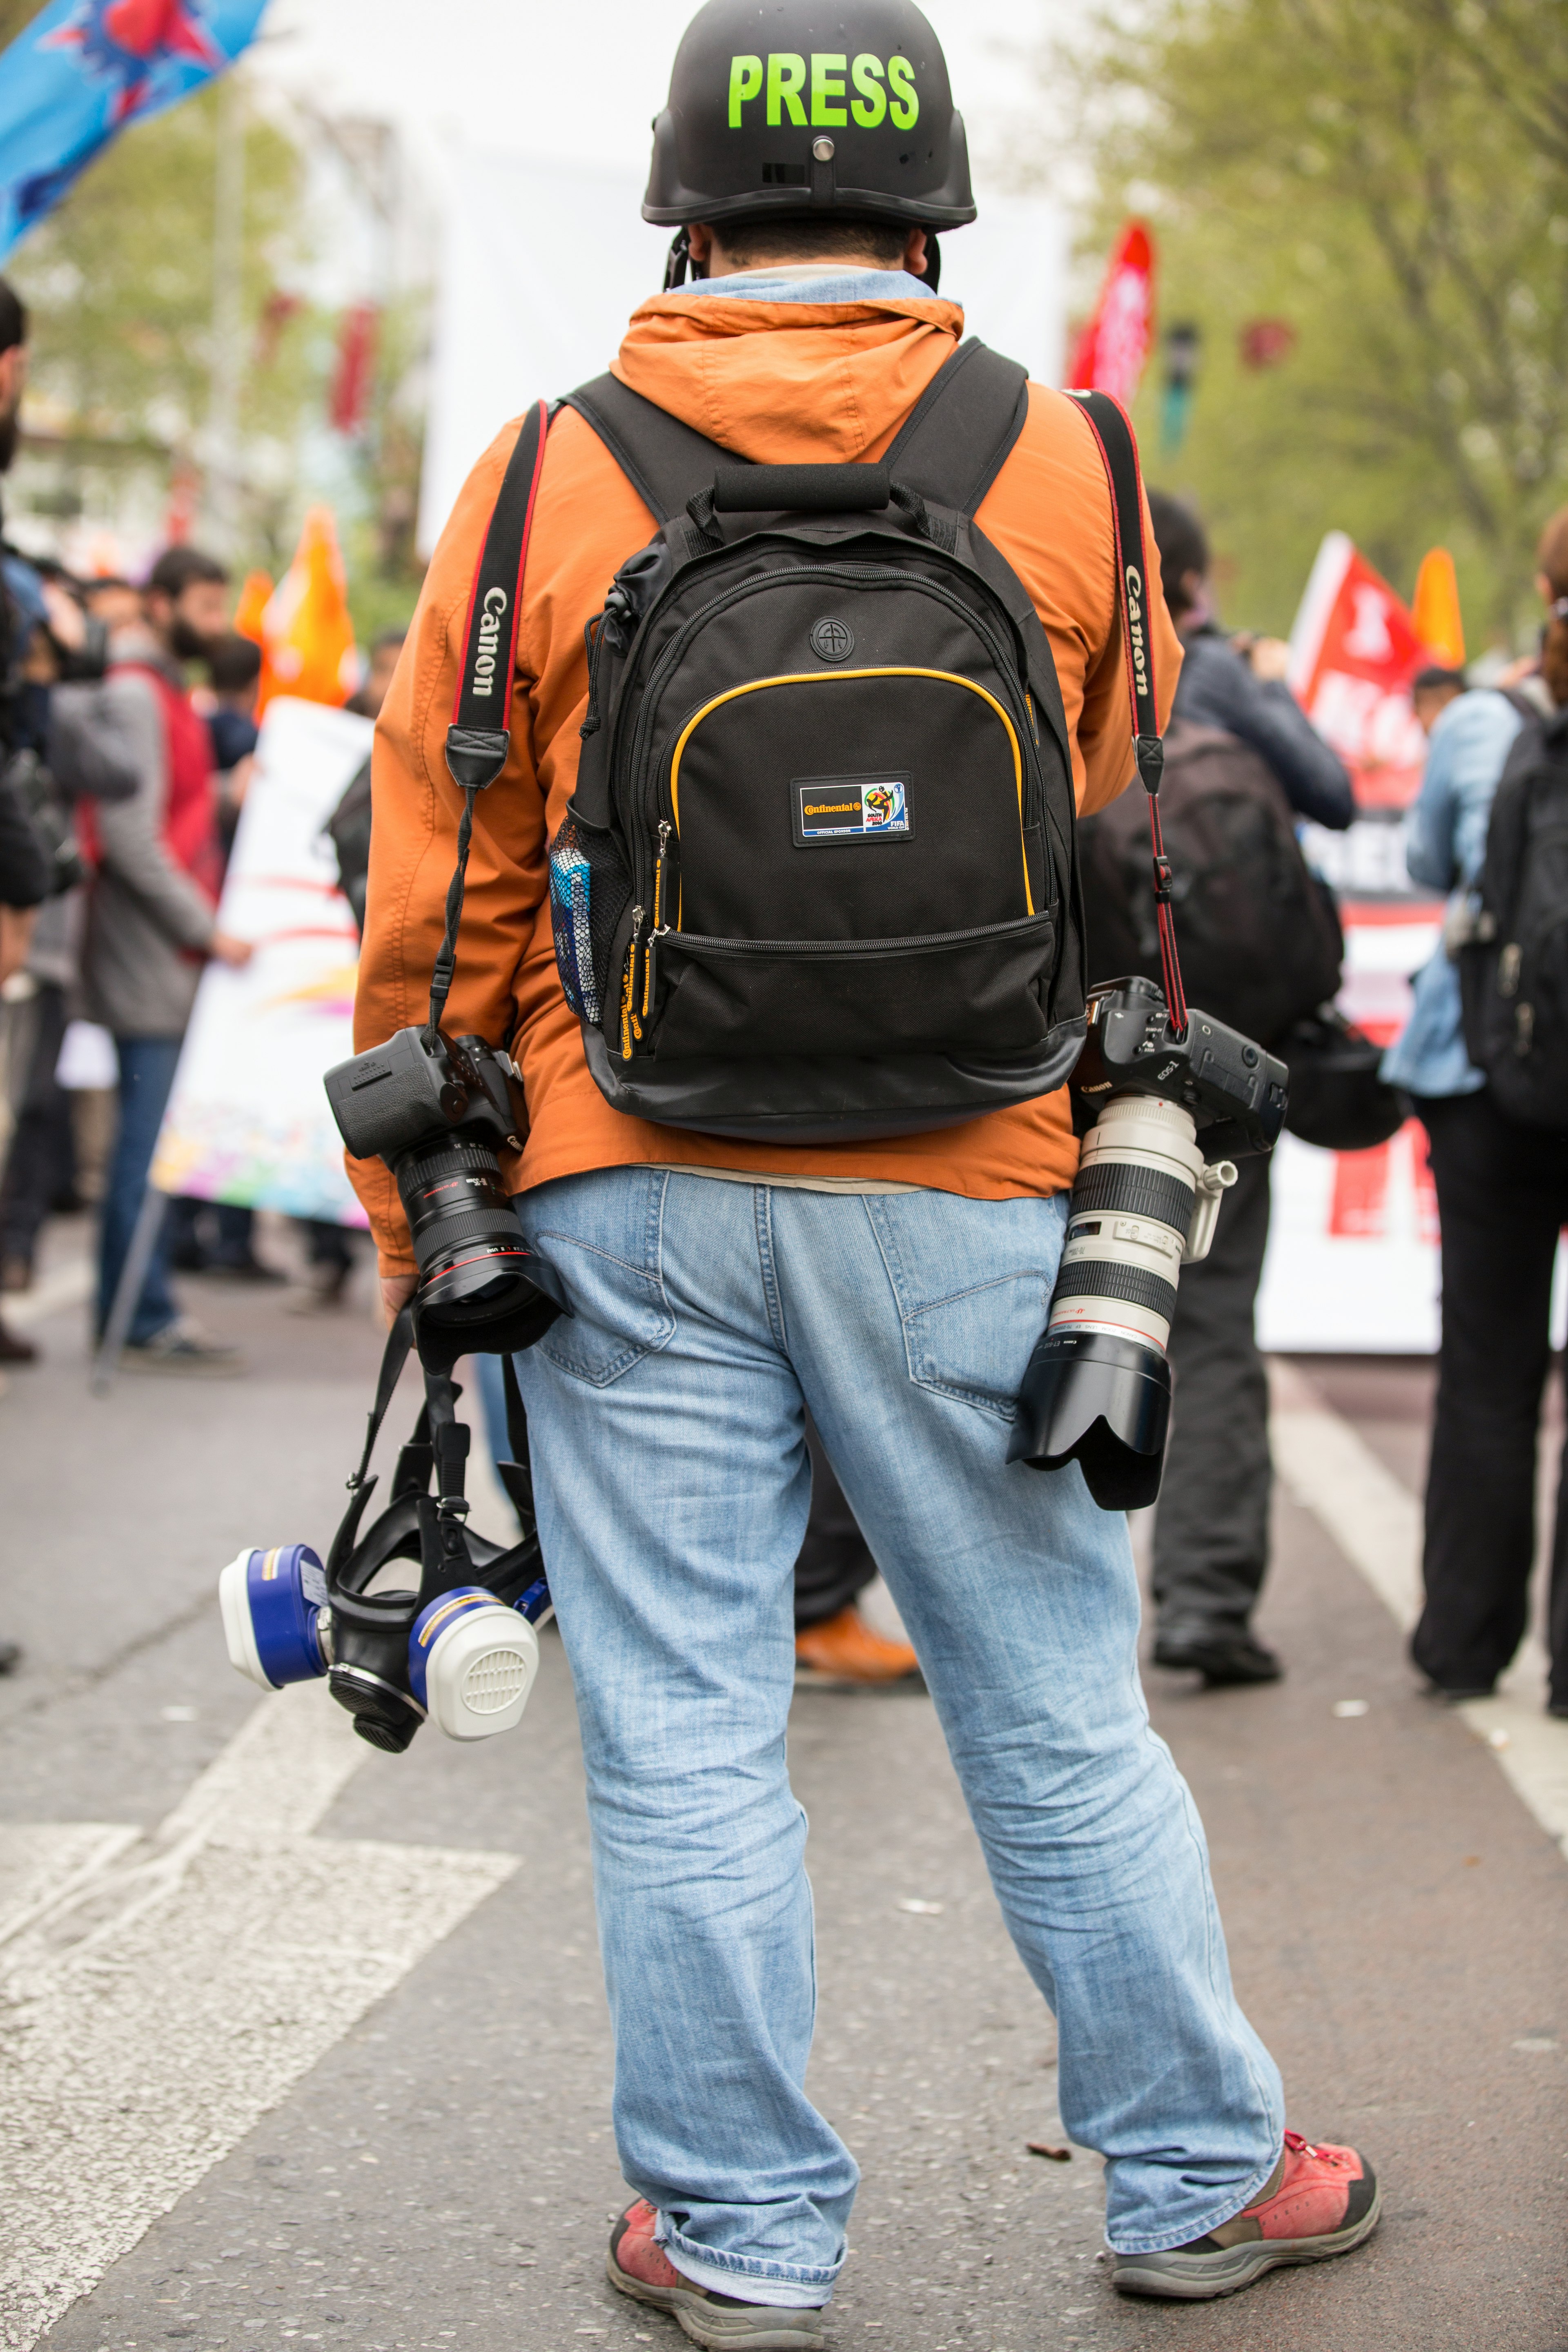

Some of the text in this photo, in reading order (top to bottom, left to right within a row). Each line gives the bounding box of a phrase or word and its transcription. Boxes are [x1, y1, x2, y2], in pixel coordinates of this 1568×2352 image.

[728, 53, 920, 130] PRESS
[472, 587, 507, 697] Canon
[1126, 565, 1148, 696] Canon
[804, 802, 853, 816] Continental
[620, 1004, 632, 1059] Continental
[1081, 1081, 1113, 1093] Canon
[1157, 1060, 1179, 1081] EOS-1
